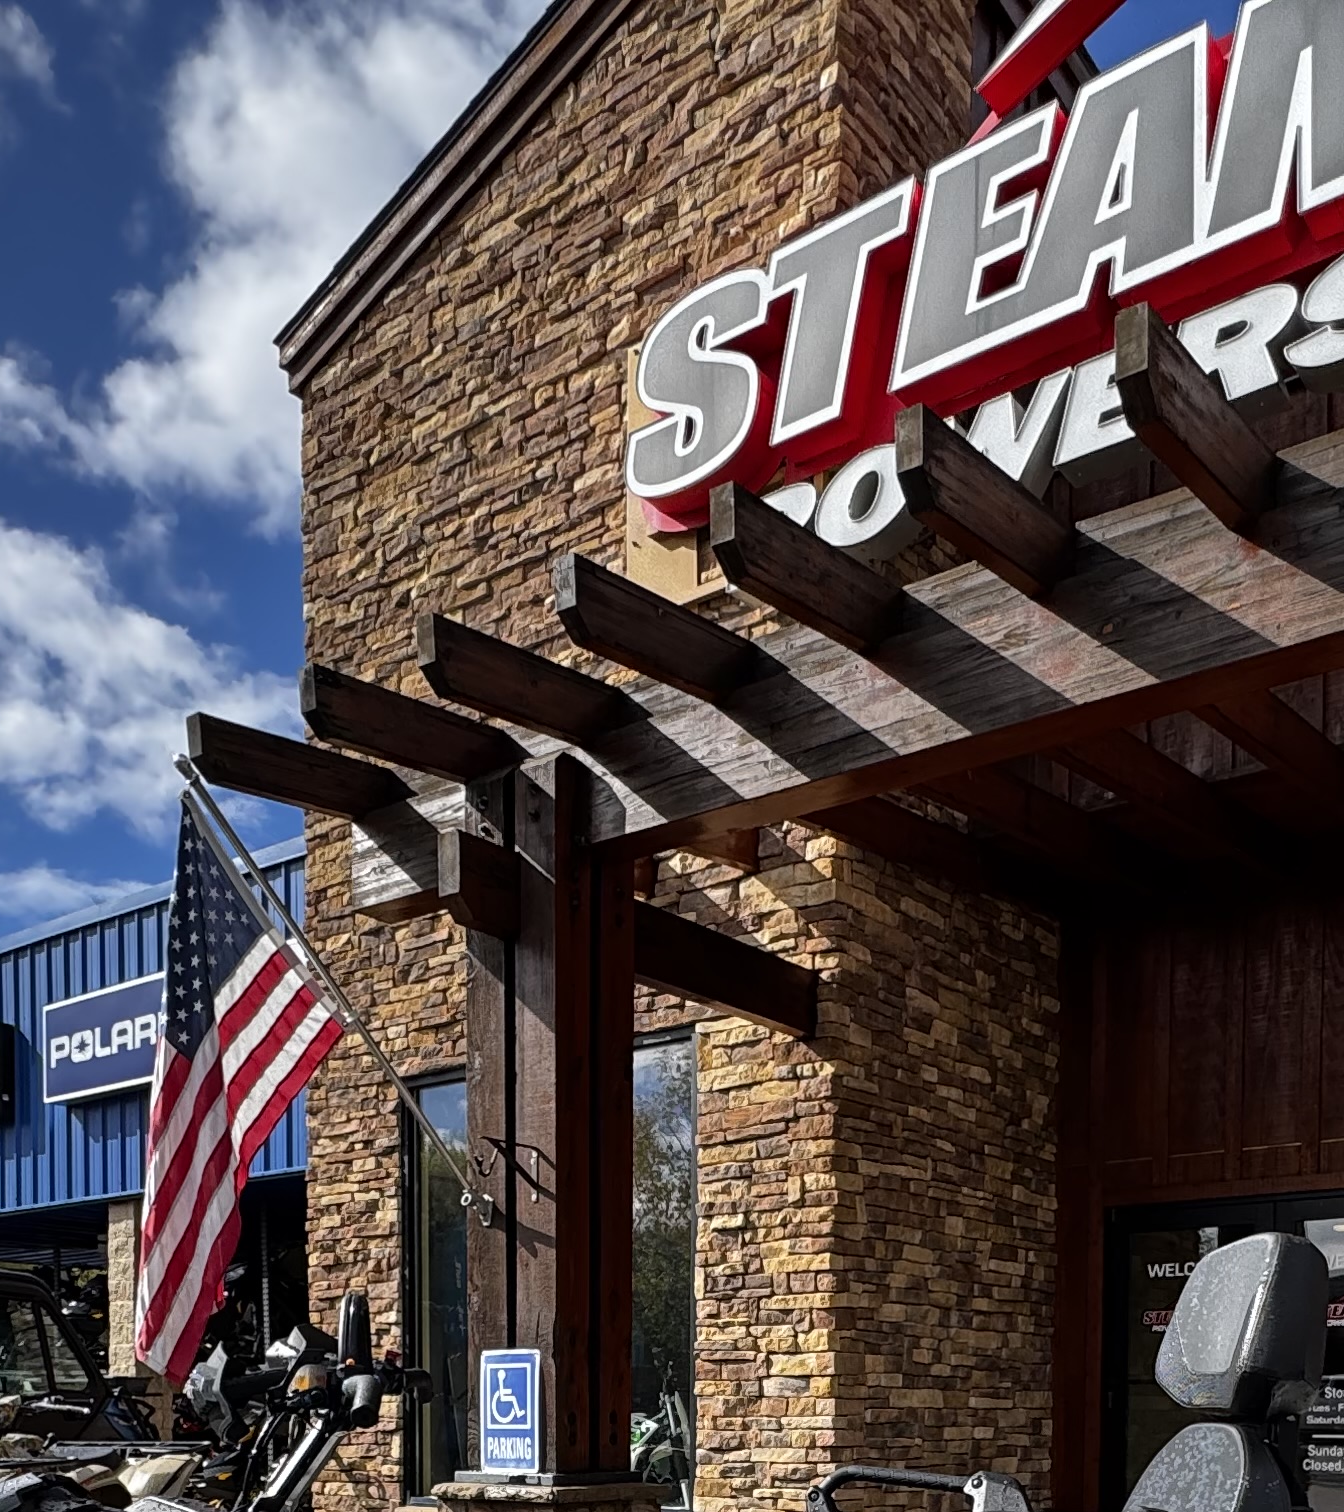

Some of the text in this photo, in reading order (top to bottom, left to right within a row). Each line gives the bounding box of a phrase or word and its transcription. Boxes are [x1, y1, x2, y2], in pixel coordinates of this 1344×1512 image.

[50, 1010, 164, 1069] POLAR
[1147, 1262, 1196, 1278] WELC
[487, 1437, 532, 1460] PARKING
[1302, 1459, 1344, 1473] Closed,
